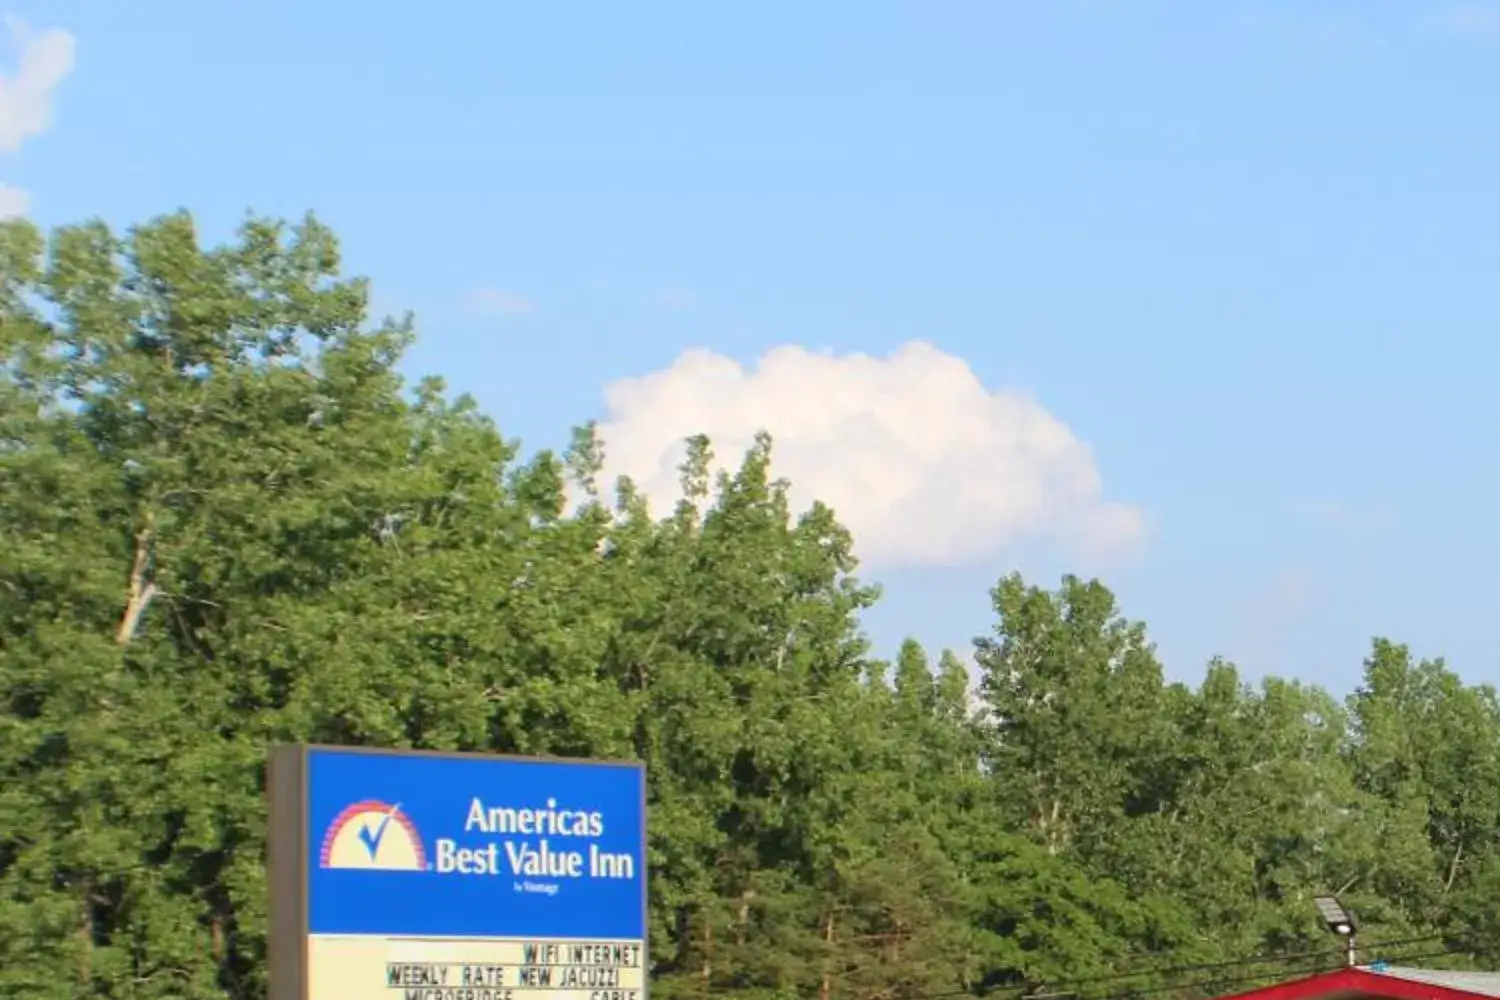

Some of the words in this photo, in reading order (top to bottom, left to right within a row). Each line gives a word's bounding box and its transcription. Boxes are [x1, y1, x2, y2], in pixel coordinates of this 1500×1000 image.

[465, 797, 604, 836] Americas
[435, 839, 498, 875] Best
[505, 842, 584, 878] Value
[590, 844, 634, 878] Inn
[566, 945, 640, 967] INTERNET
[387, 965, 449, 986] WEEKLY
[462, 966, 504, 987] RATE
[518, 967, 552, 987] NEW
[559, 968, 619, 988] JACUZZI
